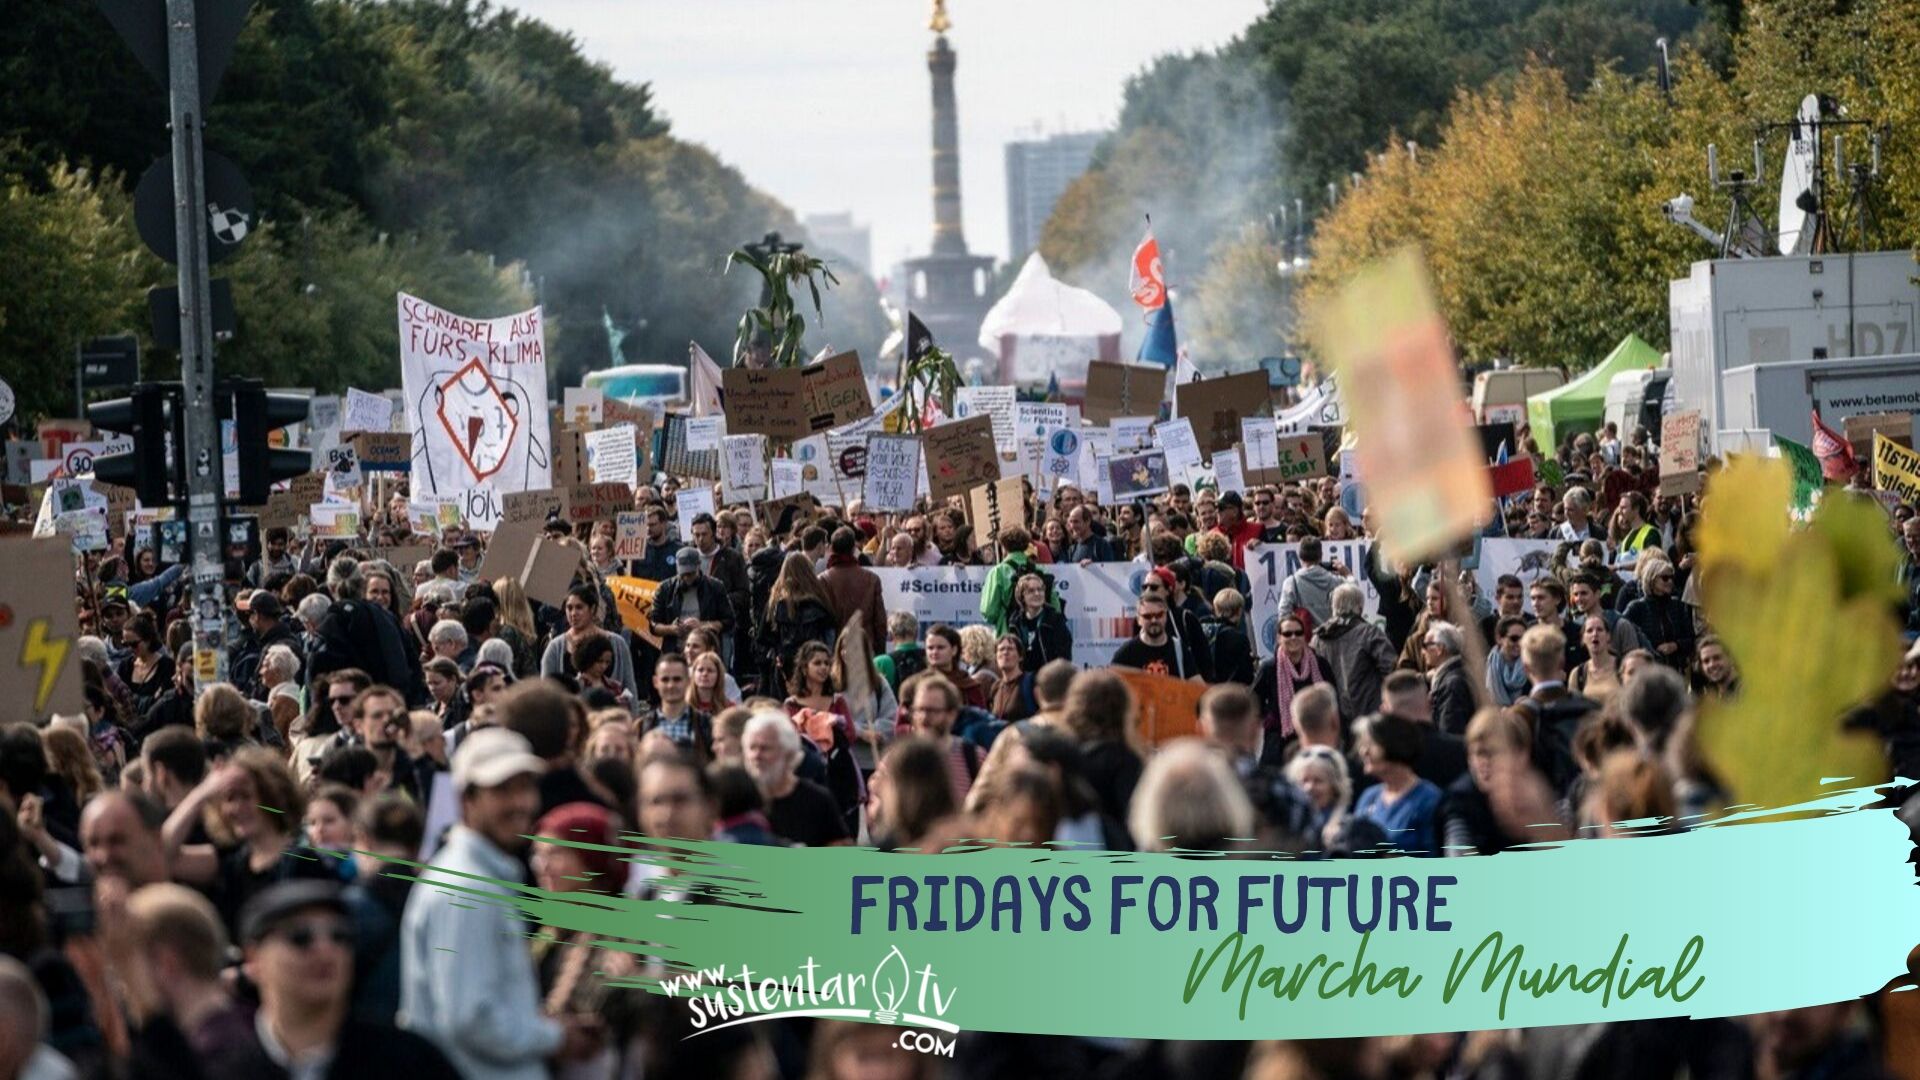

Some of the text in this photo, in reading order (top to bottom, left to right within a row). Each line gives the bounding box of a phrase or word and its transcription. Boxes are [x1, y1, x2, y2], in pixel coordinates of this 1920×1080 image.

[510, 313, 538, 341] AUF
[1827, 322, 1908, 356] HD7
[488, 341, 543, 364] KLIMA
[1019, 407, 1063, 417] Scientists
[1033, 416, 1063, 425] Future
[73, 456, 92, 473] 30
[1280, 458, 1317, 479] BABY
